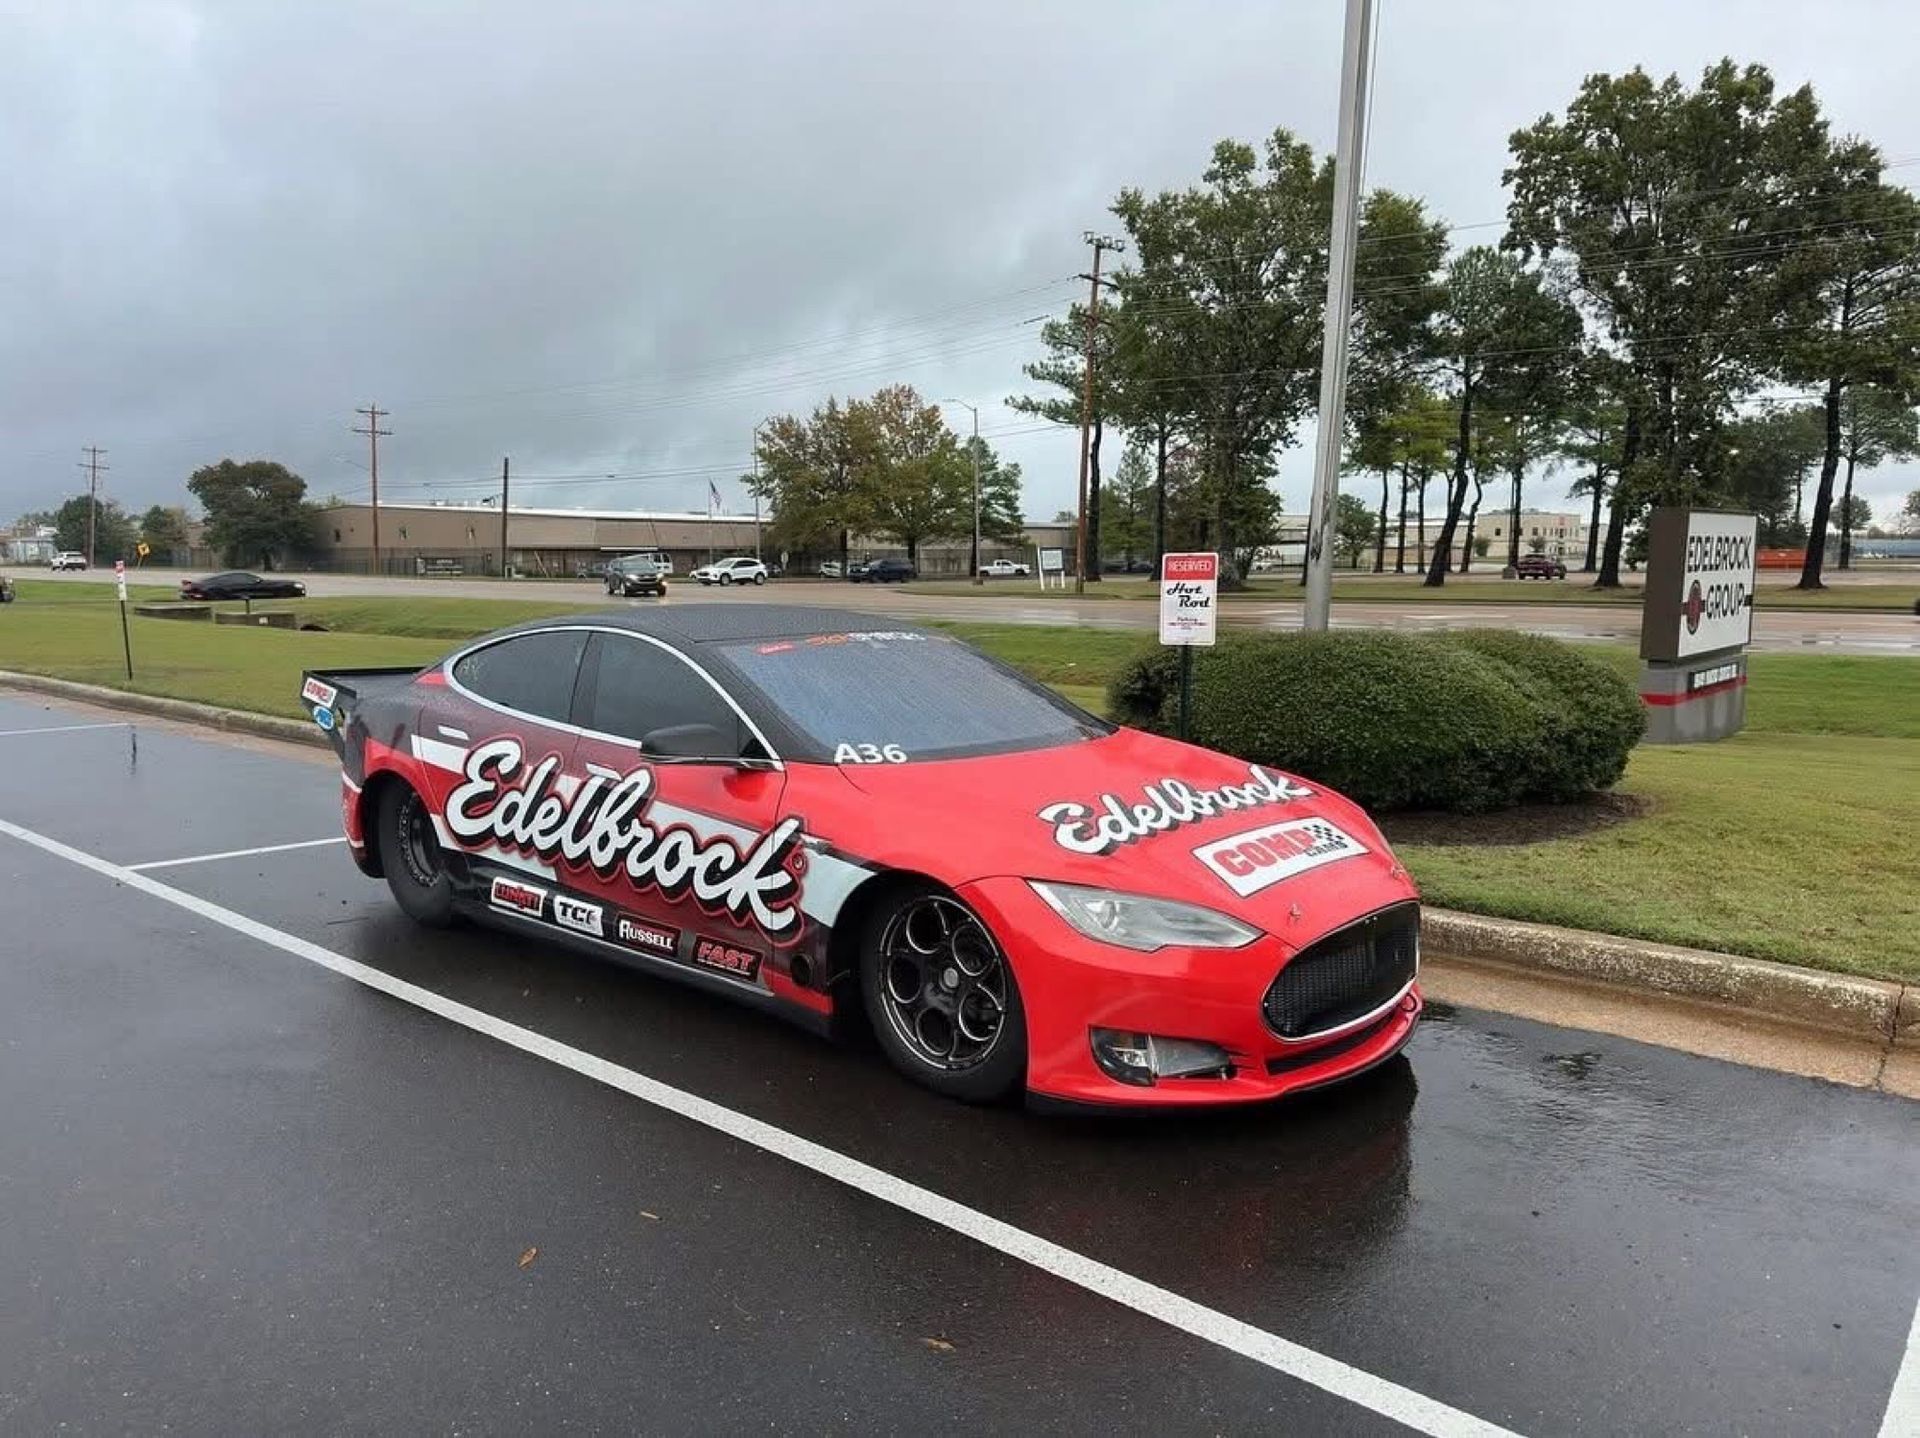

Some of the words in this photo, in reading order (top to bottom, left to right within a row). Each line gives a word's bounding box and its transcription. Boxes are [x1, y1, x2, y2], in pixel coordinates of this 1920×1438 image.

[1168, 560, 1212, 571] RESERVED
[1687, 536, 1751, 573] EDELBROCK
[1166, 582, 1203, 596] Hot
[1178, 595, 1211, 608] Rod
[1706, 583, 1744, 620] GROUP
[833, 743, 908, 765] A36
[1036, 764, 1316, 857] Edelbrock
[444, 738, 798, 933] Edelbrock
[1213, 828, 1316, 877] COMP
[699, 941, 754, 970] FAST
